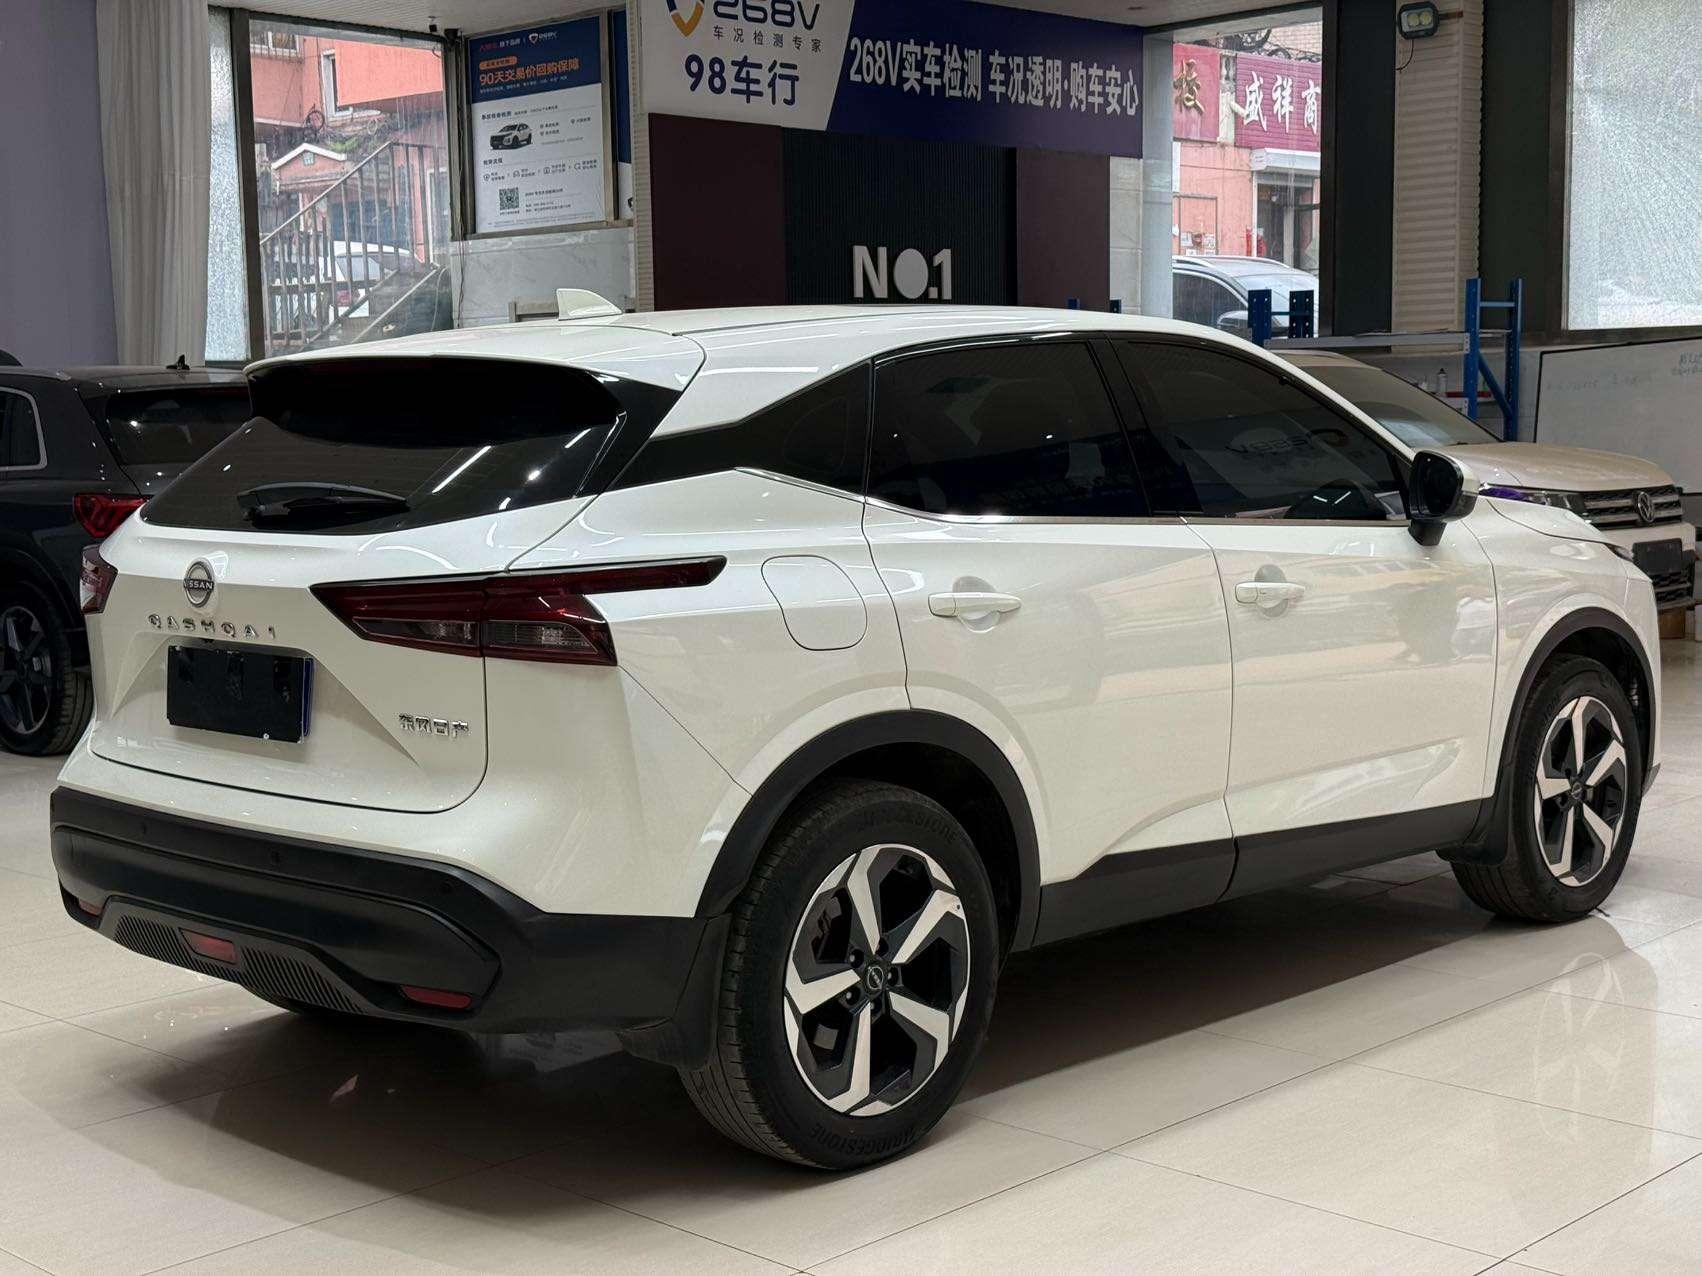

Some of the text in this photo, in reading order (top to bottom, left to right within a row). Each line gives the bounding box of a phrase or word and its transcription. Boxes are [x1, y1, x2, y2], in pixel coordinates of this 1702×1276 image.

[713, 0, 821, 31] 268V
[713, 25, 823, 53] 车况检测专家
[479, 57, 580, 86] 90天交易价回购保障
[684, 53, 800, 106] 98车行
[850, 37, 1139, 116] 268V实车检测 车况透明·购车安心
[148, 613, 277, 640] QASHQAI
[398, 713, 470, 739] 东风日产
